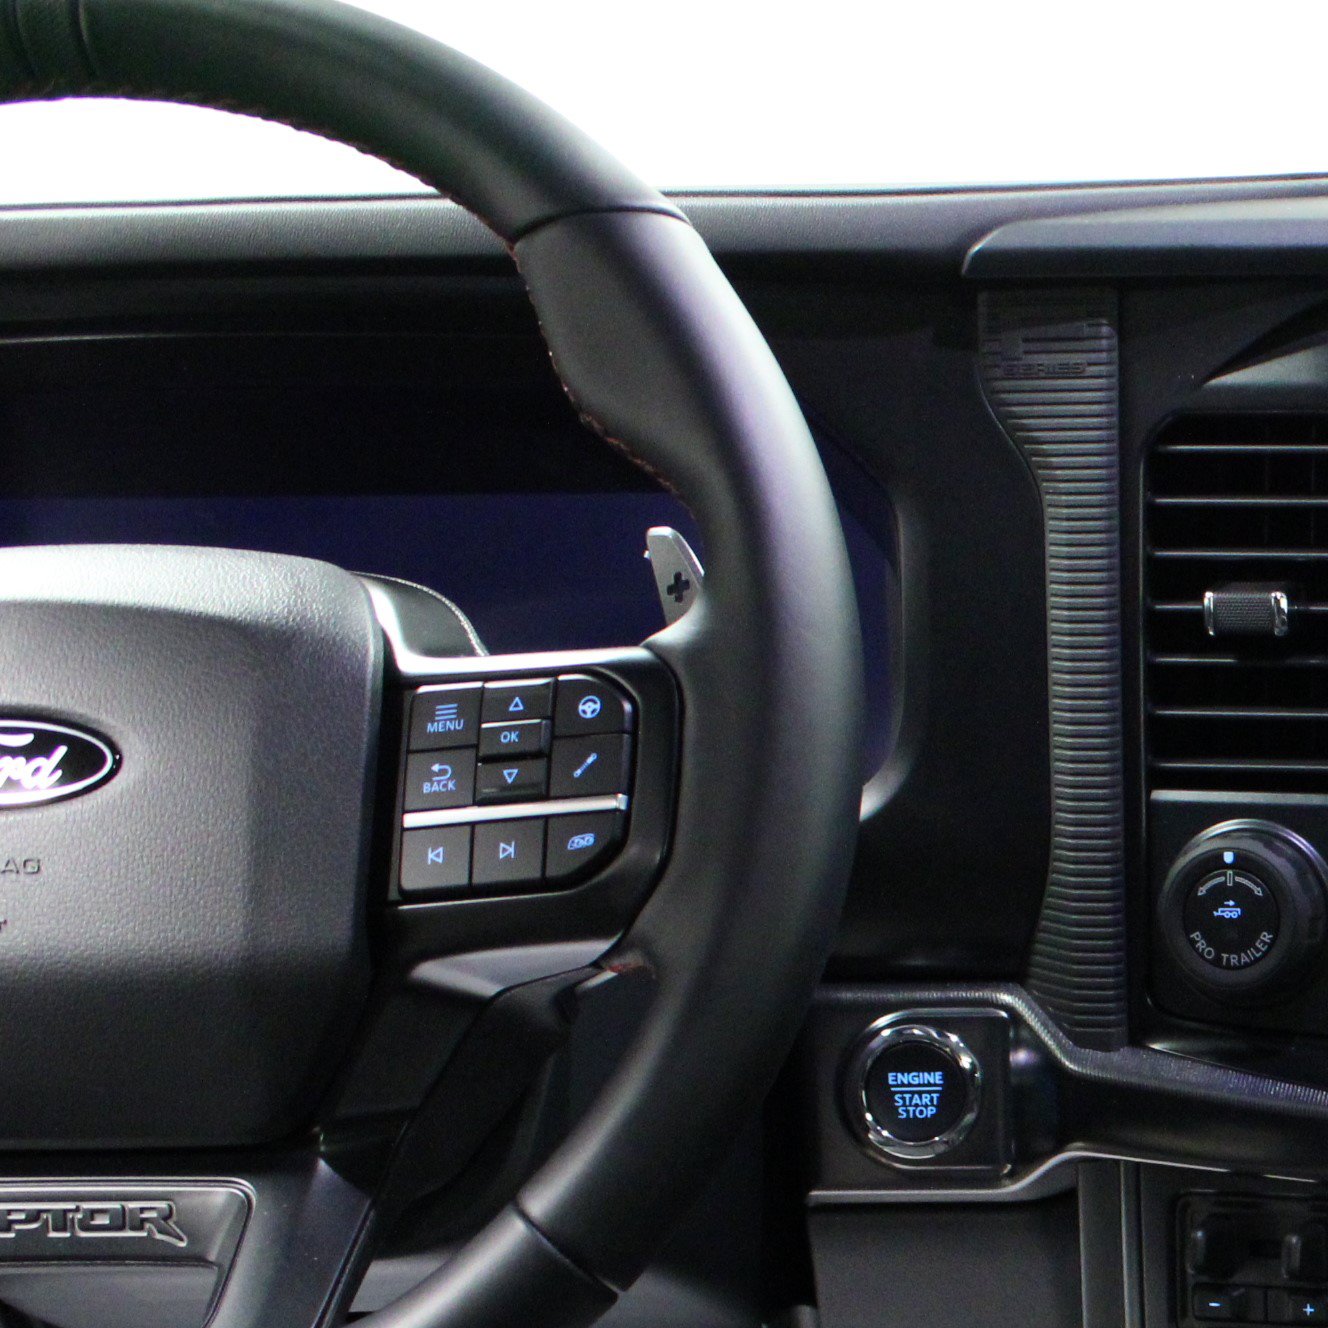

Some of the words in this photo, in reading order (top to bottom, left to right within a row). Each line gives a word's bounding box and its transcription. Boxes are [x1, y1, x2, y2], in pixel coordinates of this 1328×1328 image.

[427, 719, 464, 733] MENU
[500, 731, 519, 743] OK
[422, 780, 456, 794] BACK
[1189, 931, 1216, 960] PRO
[1220, 930, 1274, 966] TRAILER
[888, 1071, 944, 1085] ENGINE
[894, 1093, 940, 1107] START
[898, 1106, 937, 1119] STOP
